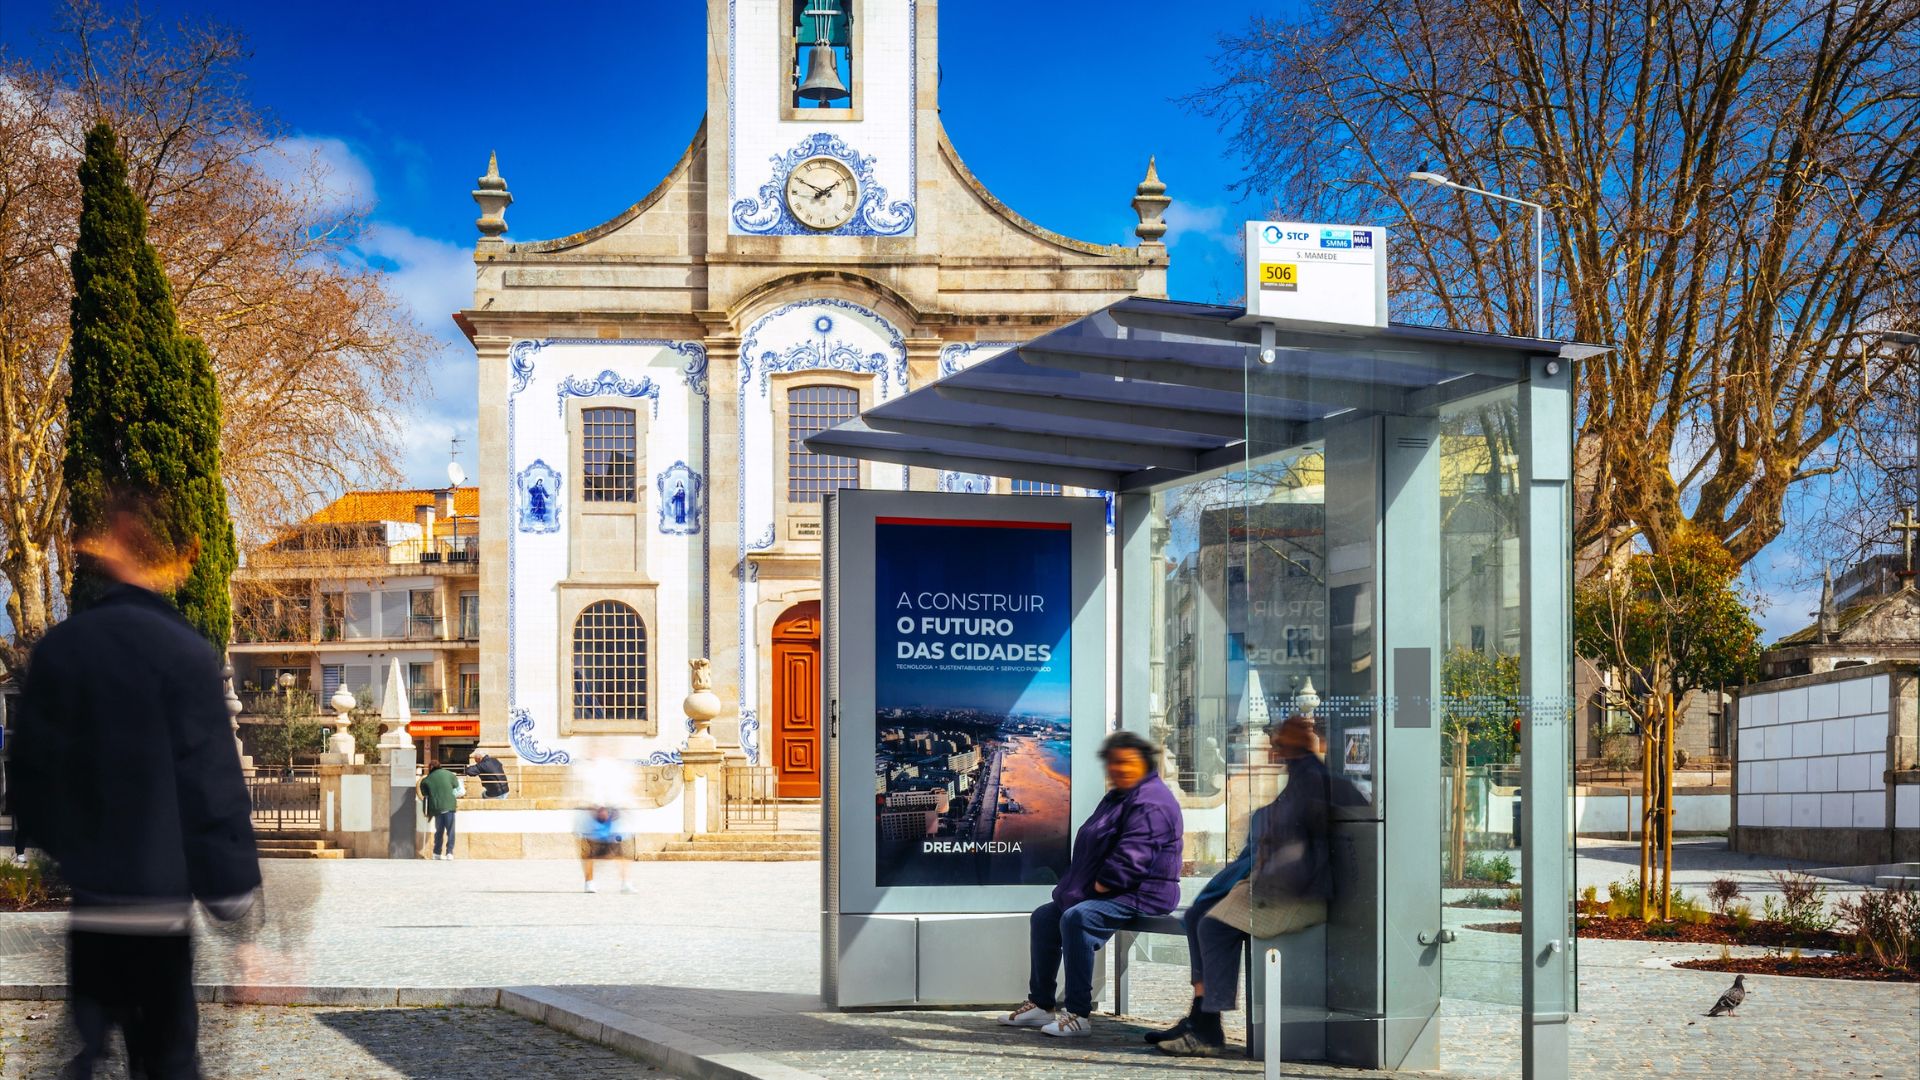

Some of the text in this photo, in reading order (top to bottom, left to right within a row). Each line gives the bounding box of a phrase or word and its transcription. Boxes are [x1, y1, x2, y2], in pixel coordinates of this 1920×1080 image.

[1286, 232, 1310, 240] STCP
[1296, 251, 1338, 261] S. MAMEDE
[1266, 266, 1292, 280] 506
[896, 592, 1044, 612] A CONSTRUIR
[896, 616, 1014, 636] O FUTURO
[897, 641, 1052, 662] DAS CIDADES
[939, 664, 995, 672] SUSTENTABILIDADE
